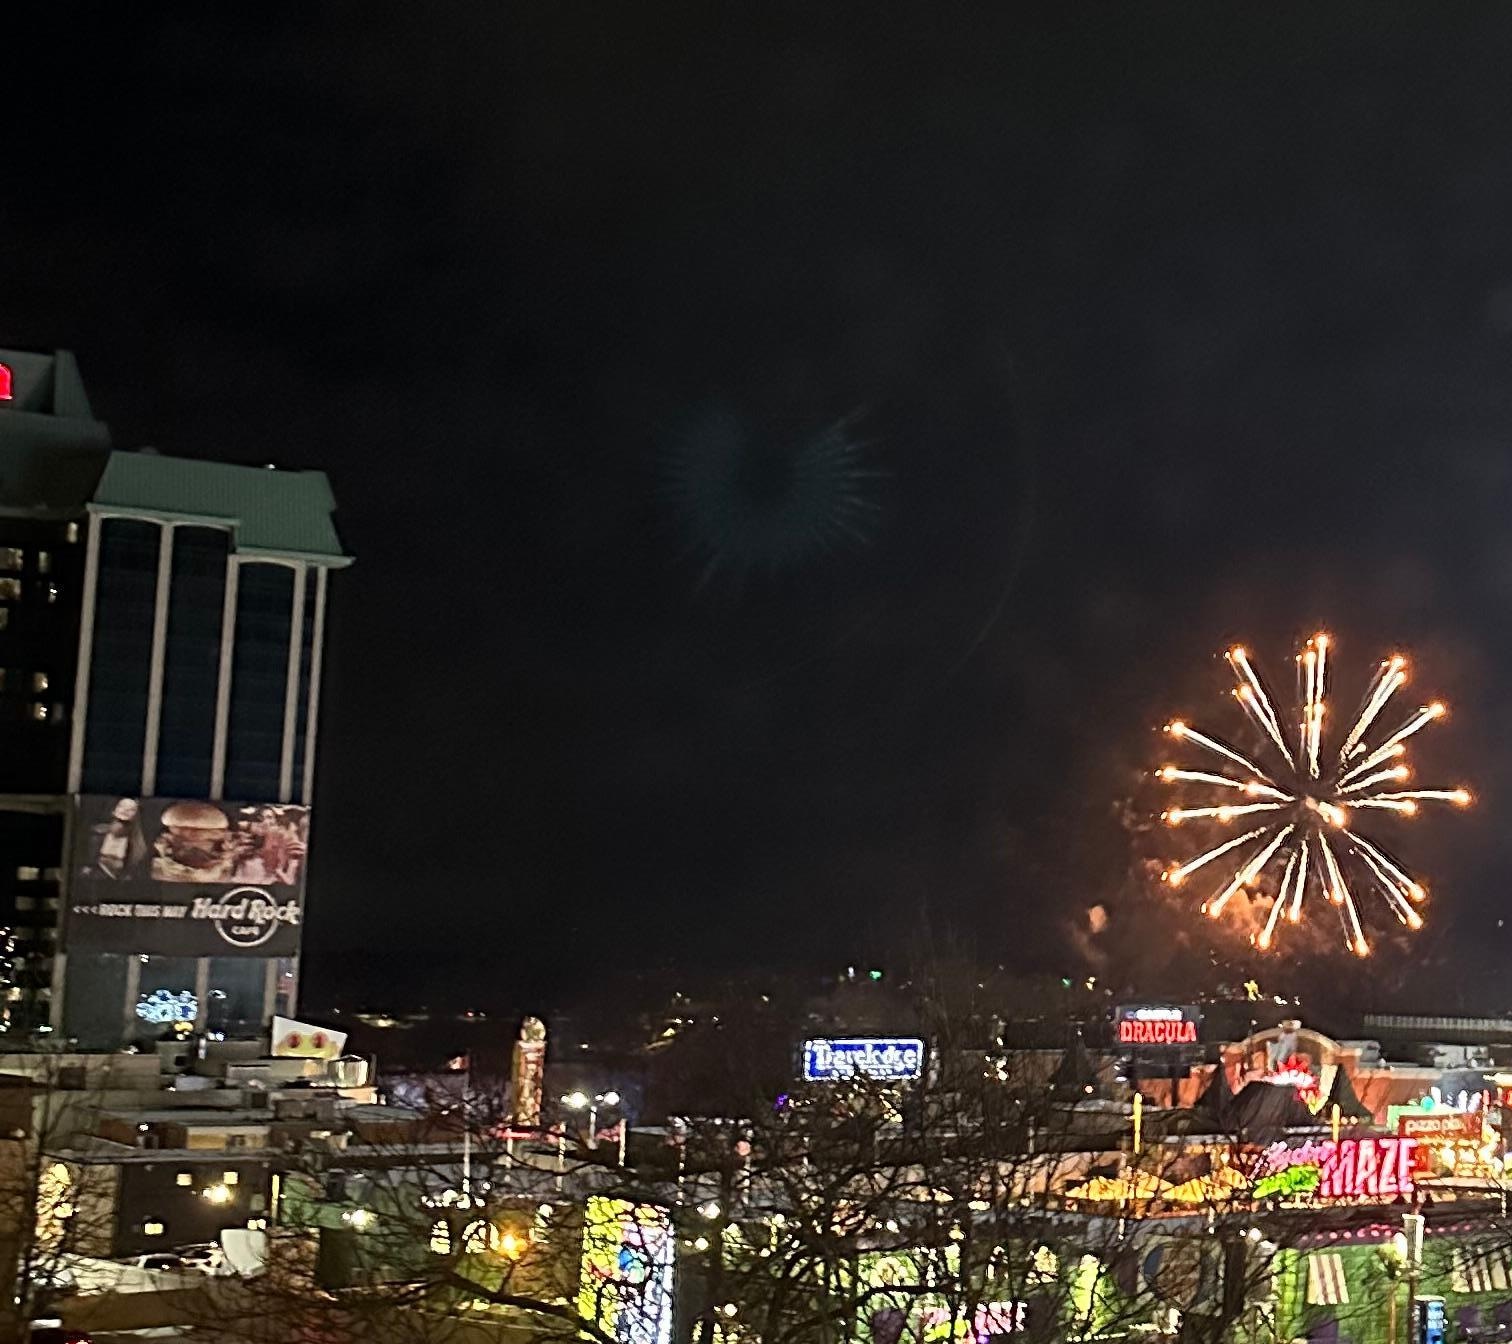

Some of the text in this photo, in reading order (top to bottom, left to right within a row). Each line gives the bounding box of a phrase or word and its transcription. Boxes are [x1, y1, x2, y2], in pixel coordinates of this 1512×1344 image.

[190, 897, 300, 925] Hard Rock
[1120, 1021, 1197, 1044] DRACULA
[1320, 1138, 1417, 1196] MAZE
